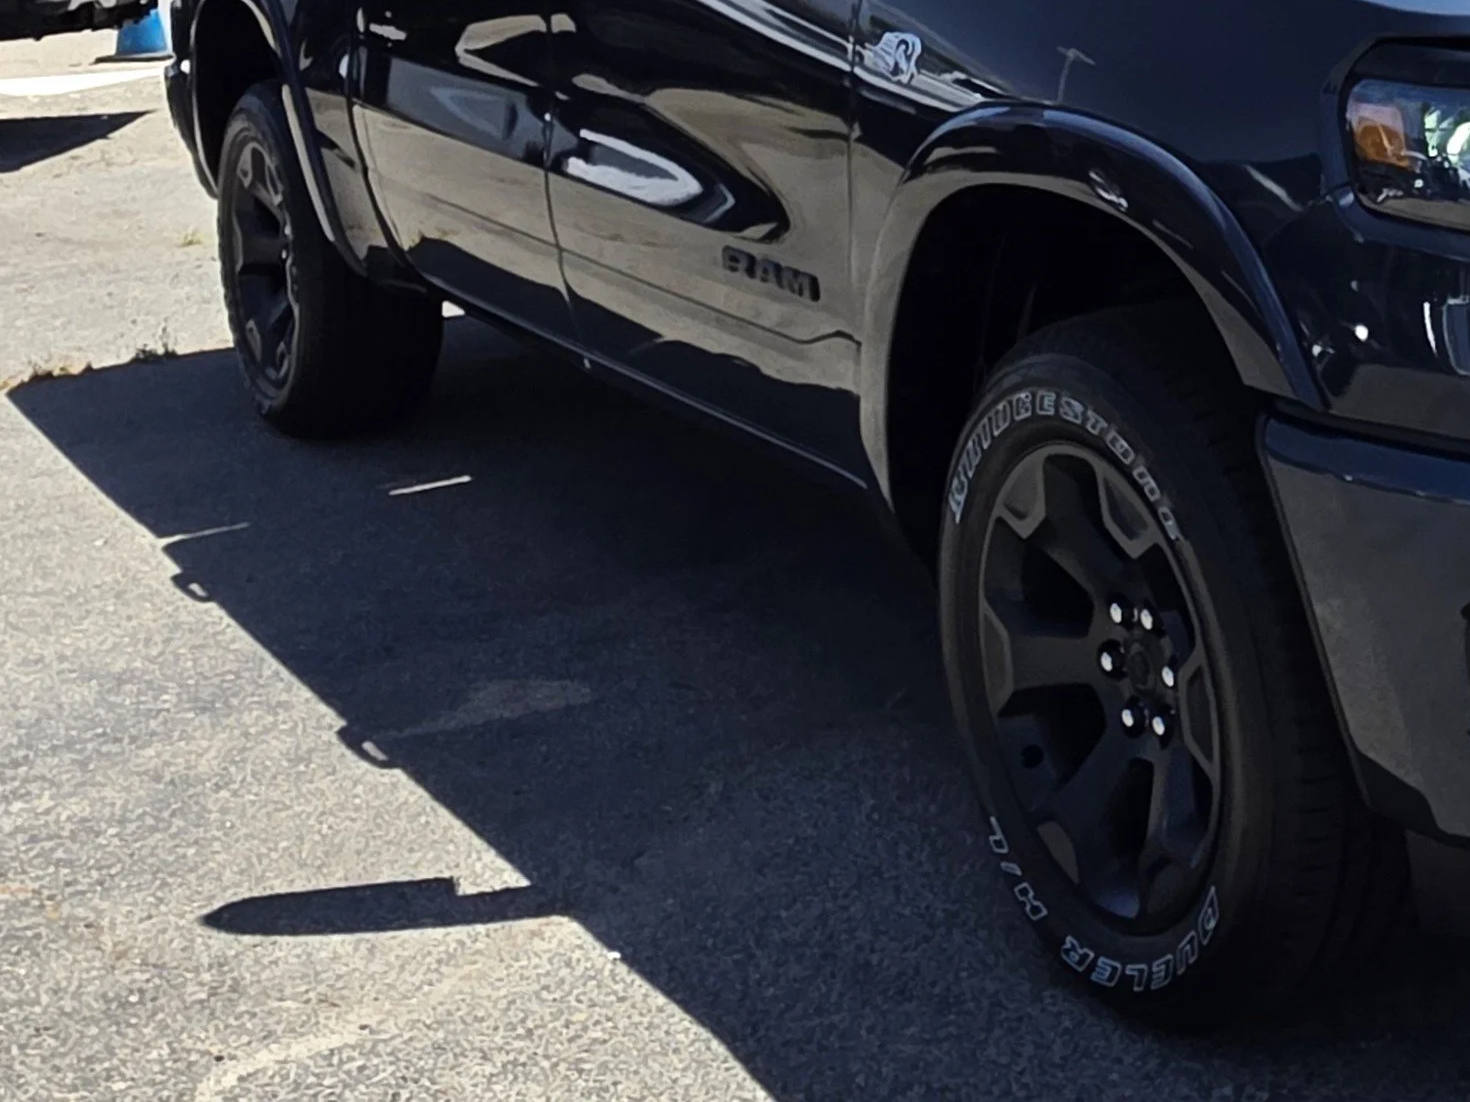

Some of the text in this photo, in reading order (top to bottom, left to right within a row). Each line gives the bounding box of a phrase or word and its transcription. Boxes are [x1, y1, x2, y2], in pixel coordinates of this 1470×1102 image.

[721, 244, 821, 303] RAM
[948, 390, 1182, 540] BRIDGESTONE
[1060, 884, 1221, 993] DUELER
